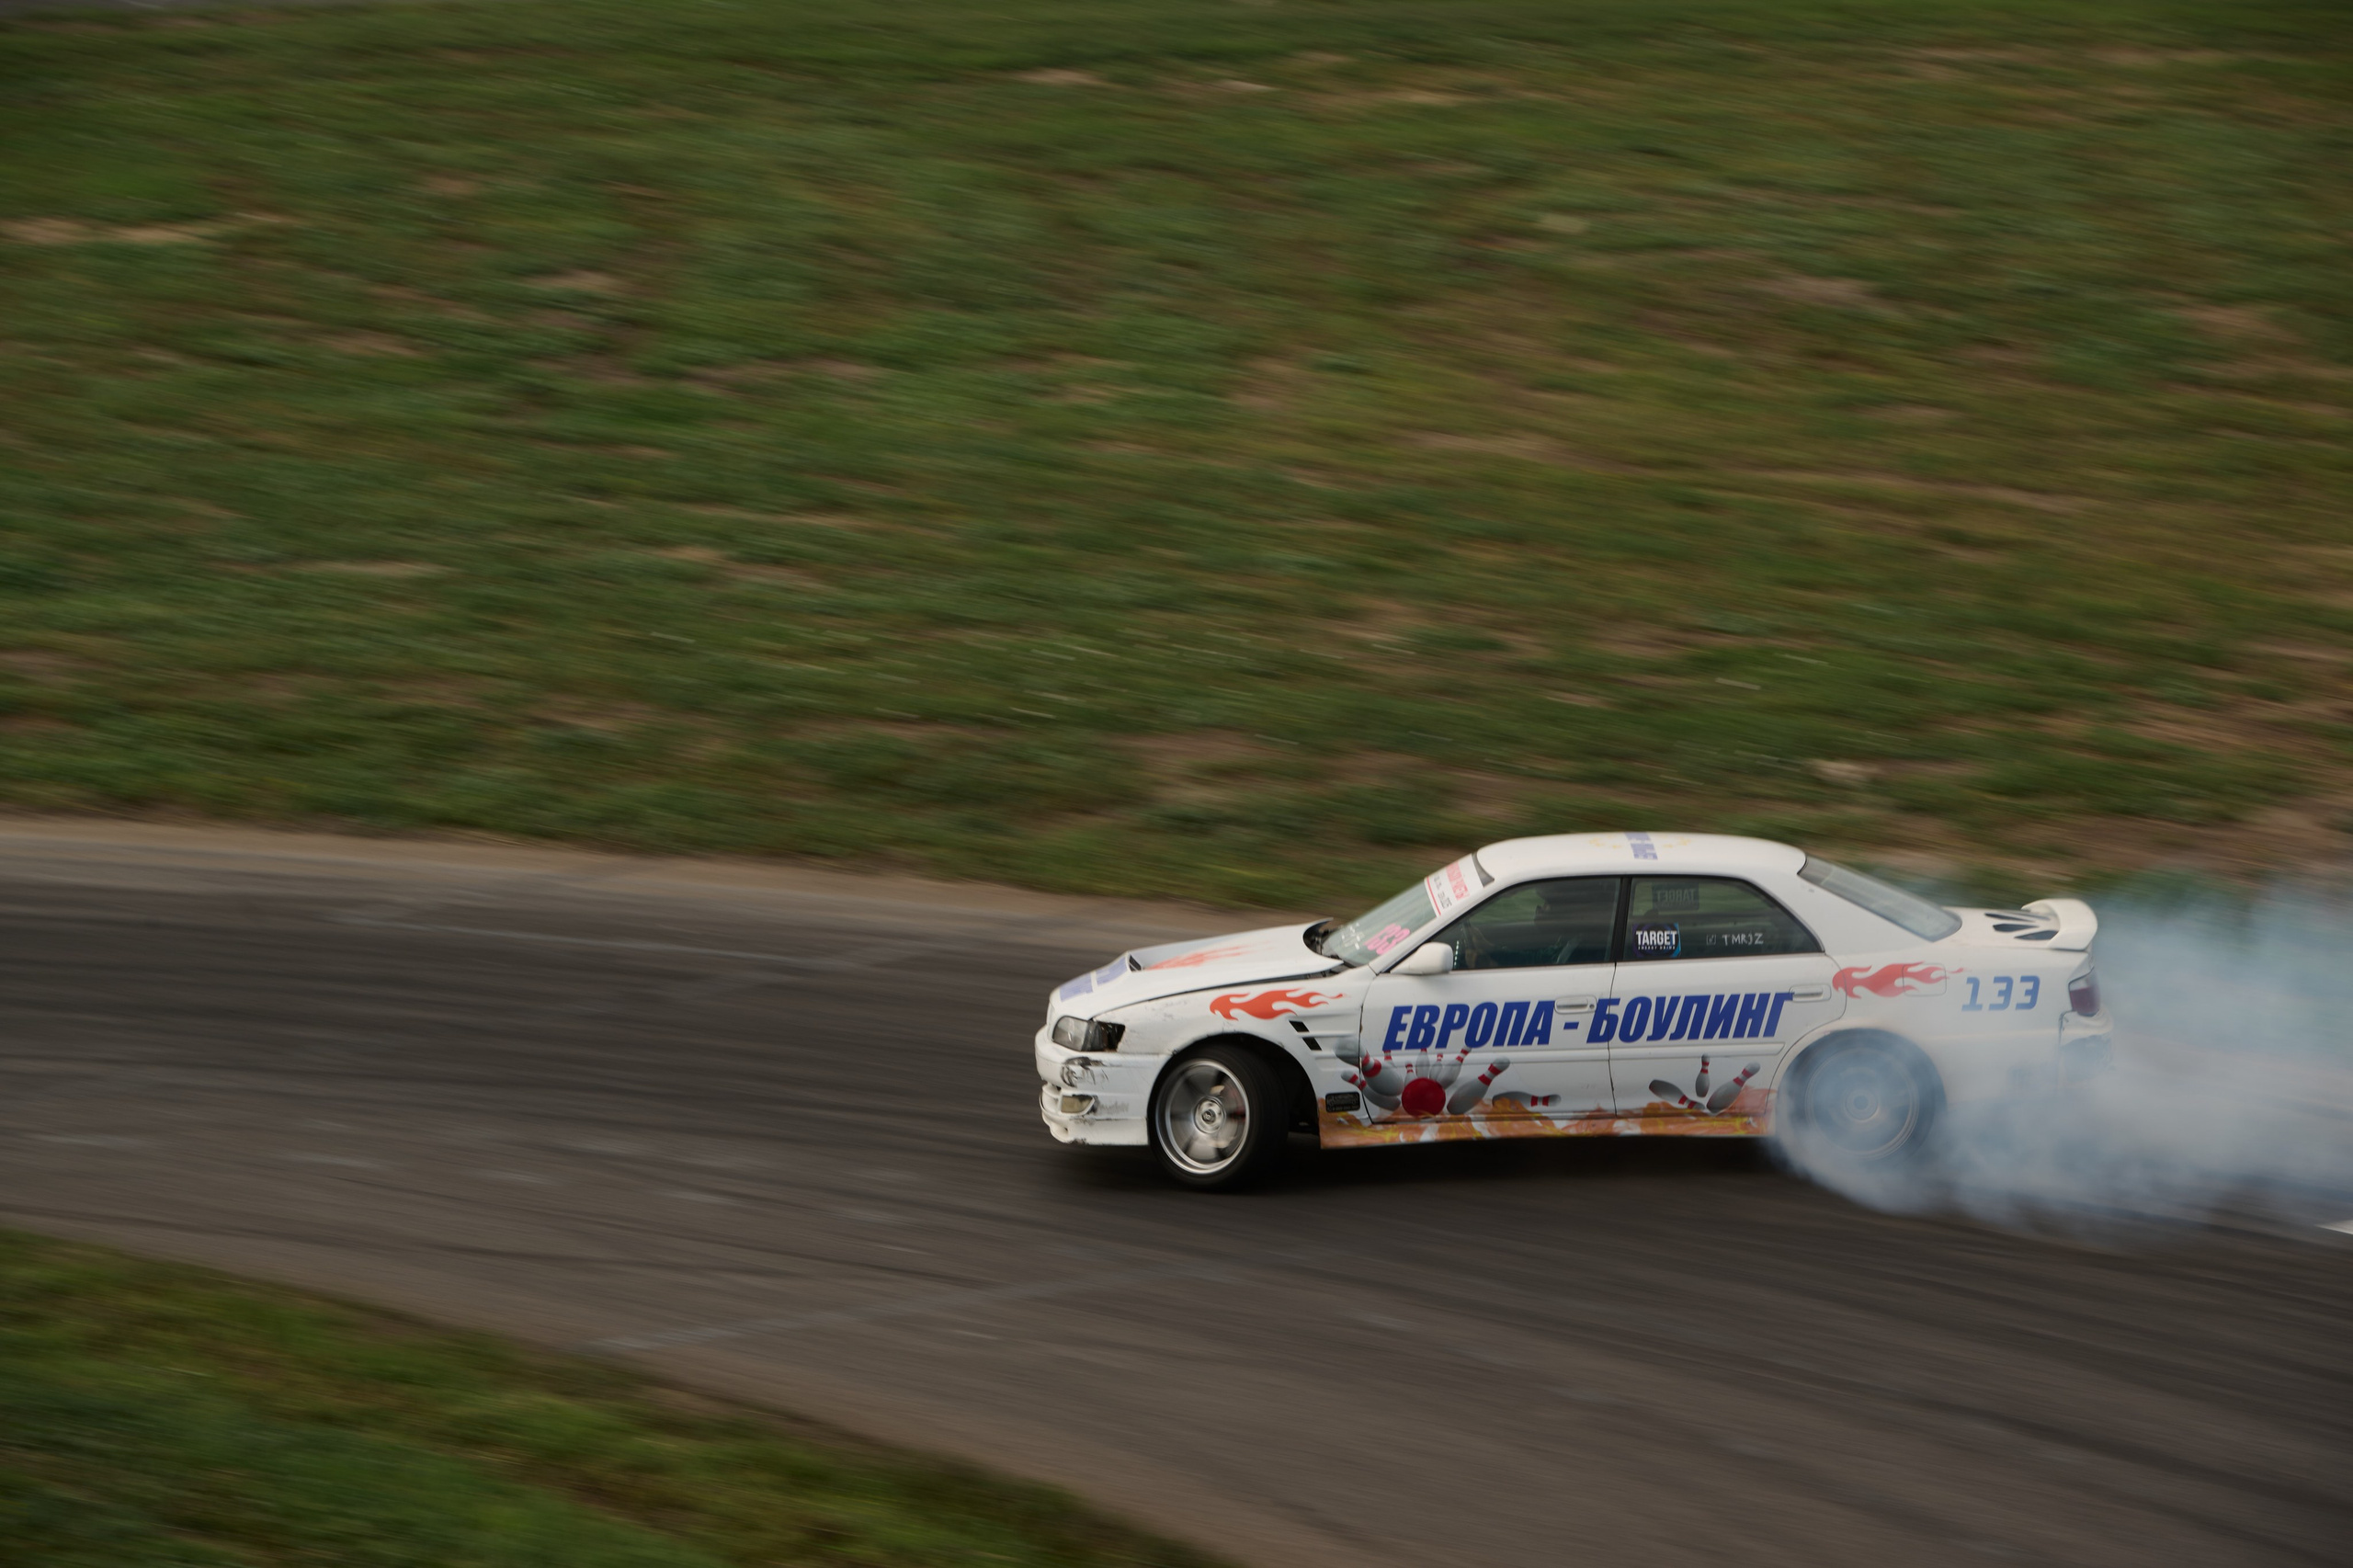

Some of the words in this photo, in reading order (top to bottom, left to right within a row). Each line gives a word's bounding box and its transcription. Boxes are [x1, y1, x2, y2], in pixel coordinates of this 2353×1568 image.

[1364, 923, 1410, 955] 133
[1635, 930, 1677, 946] TARGET
[1961, 975, 2040, 1011] 133
[1382, 1000, 1555, 1051] ЕВРОПА
[1586, 993, 1795, 1043] БОУЛИНГ
